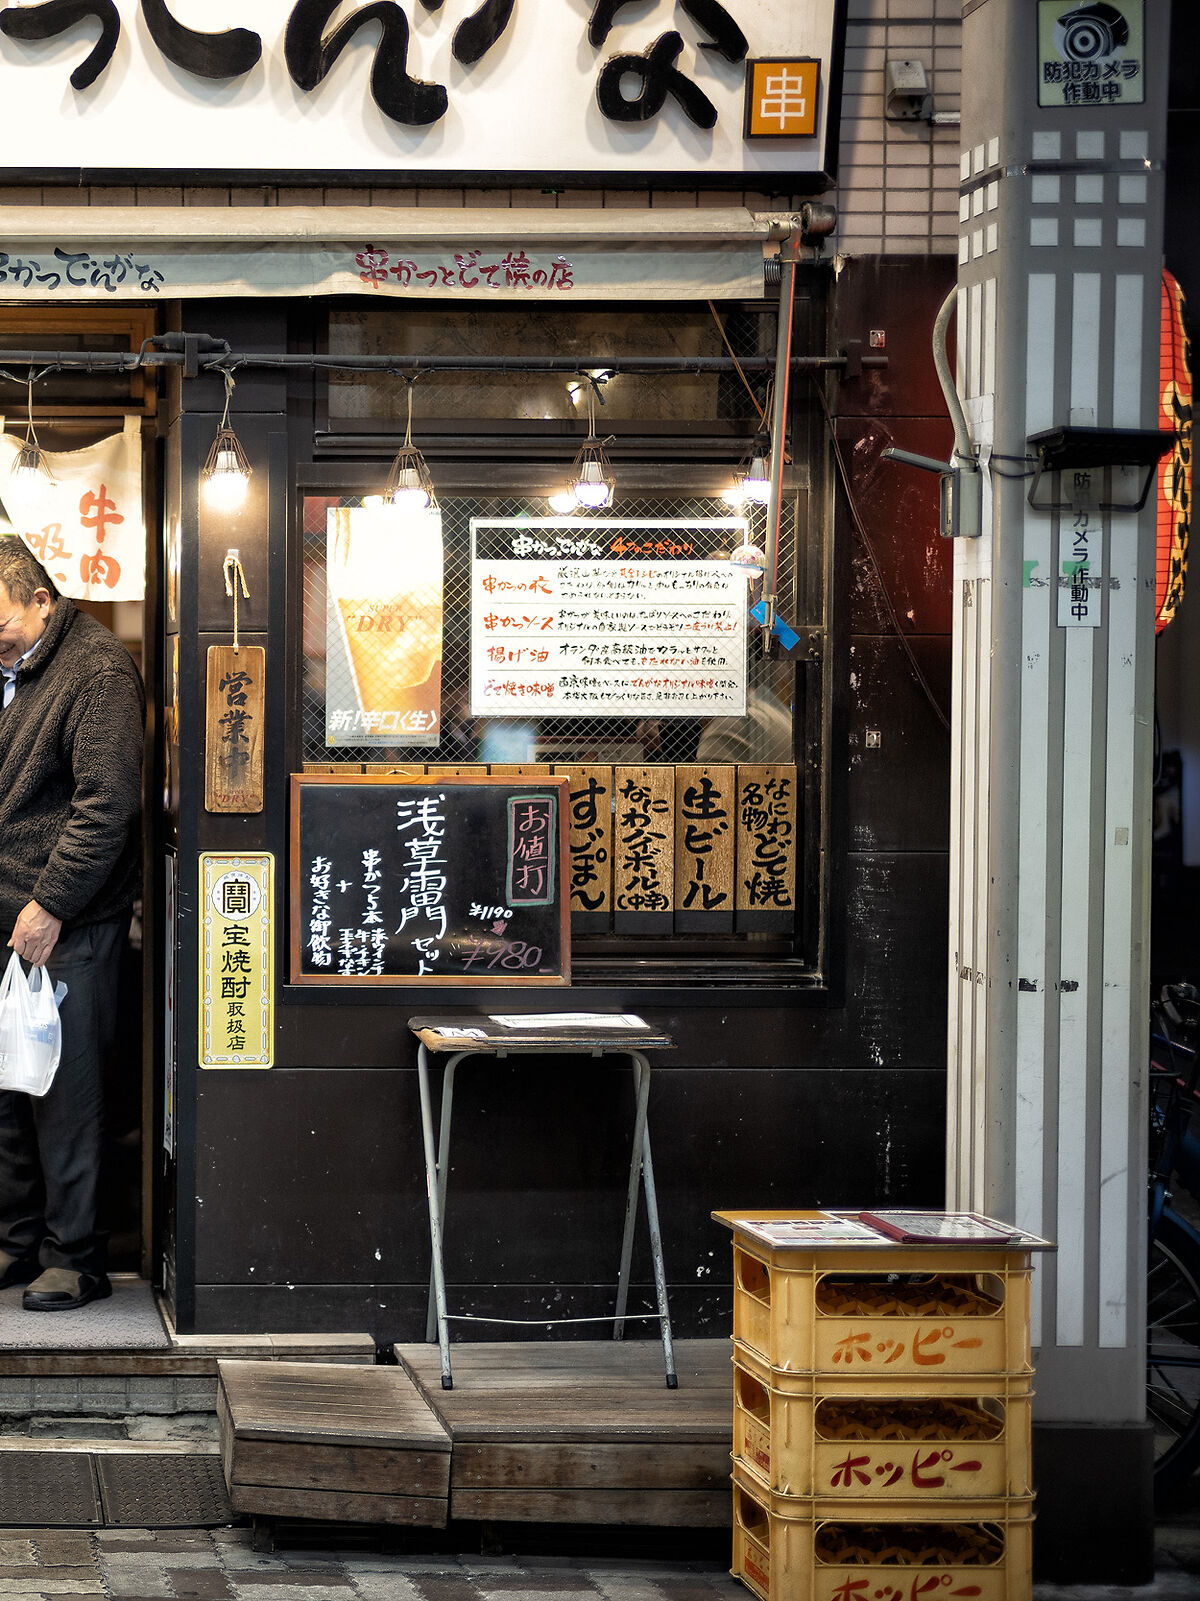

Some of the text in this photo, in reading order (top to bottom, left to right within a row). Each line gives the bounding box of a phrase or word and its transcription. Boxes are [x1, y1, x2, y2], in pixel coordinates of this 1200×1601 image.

[1043, 59, 1141, 83] 防犯カメラ
[1062, 82, 1122, 104] 作動中
[759, 66, 807, 131] 串
[355, 243, 575, 290] 串かつとどて焼の店
[79, 483, 125, 589] 牛肉
[1071, 472, 1091, 622] 防カメラ作動中
[483, 612, 553, 631] 串かつソース
[486, 646, 549, 664] 揚げ油
[218, 670, 253, 781] 営業中
[513, 805, 550, 896] お値打
[681, 778, 730, 909] 生ビール
[831, 1326, 983, 1366] ホッピー
[830, 1449, 982, 1488] ホッピー
